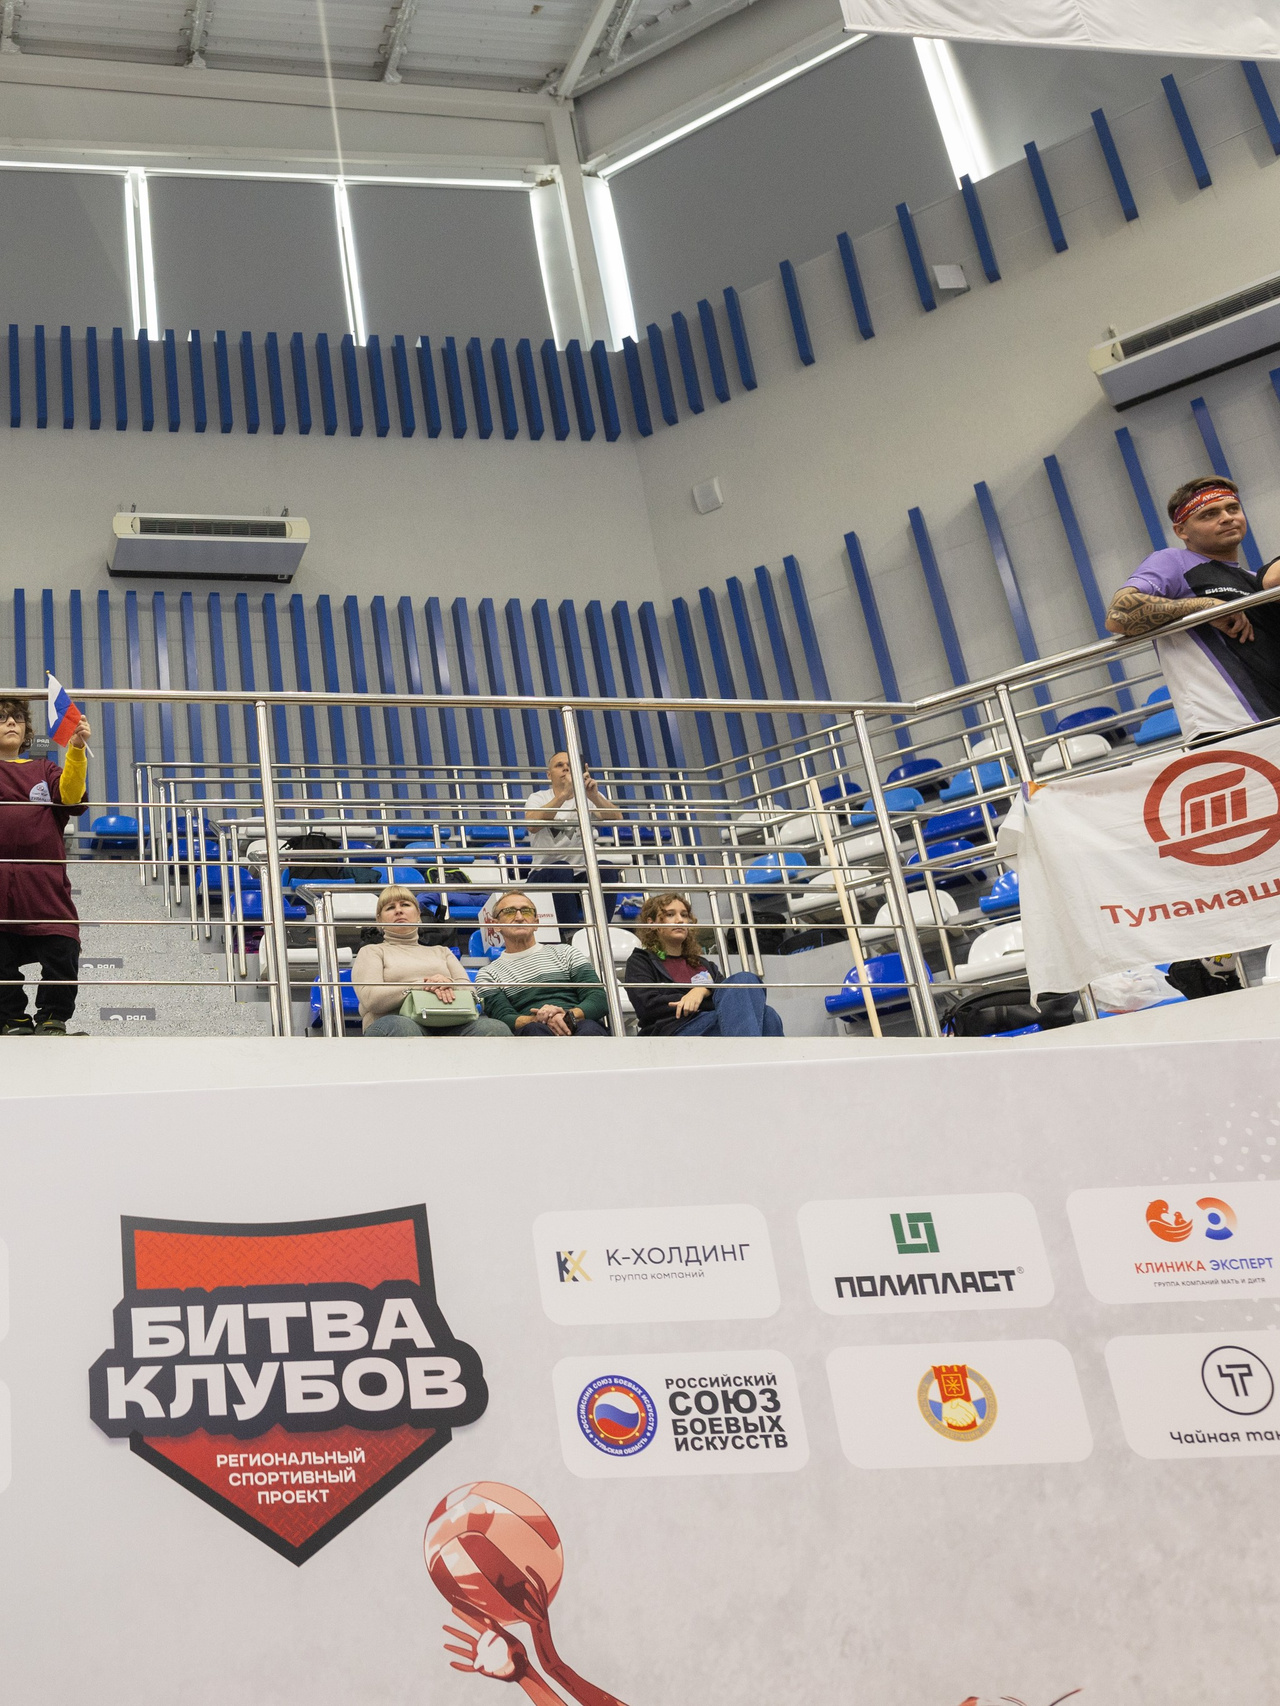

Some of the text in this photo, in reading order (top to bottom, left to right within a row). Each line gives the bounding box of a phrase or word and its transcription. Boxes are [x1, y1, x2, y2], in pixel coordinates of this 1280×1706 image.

[606, 1243, 750, 1266] К-ХОЛДИНГ
[609, 1269, 705, 1283] группа компаний
[1134, 1257, 1273, 1274] КЛИНИКА ЭКСПЕРТ
[130, 1297, 436, 1359] БИТВА
[106, 1355, 468, 1421] КЛУБОВ
[665, 1373, 778, 1389] РОССИЙСКИЙ
[667, 1387, 782, 1417] СОЮЗ
[670, 1415, 786, 1436] БОЕВЫХ
[674, 1434, 789, 1452] ИСКУССТВ
[1169, 1429, 1241, 1444] Чайная
[216, 1447, 366, 1468] РЕГИОНАЛЬНЫЙ
[228, 1466, 356, 1487] СПОРТИВНЫЙ
[257, 1488, 330, 1505] ПРОЕКТ
